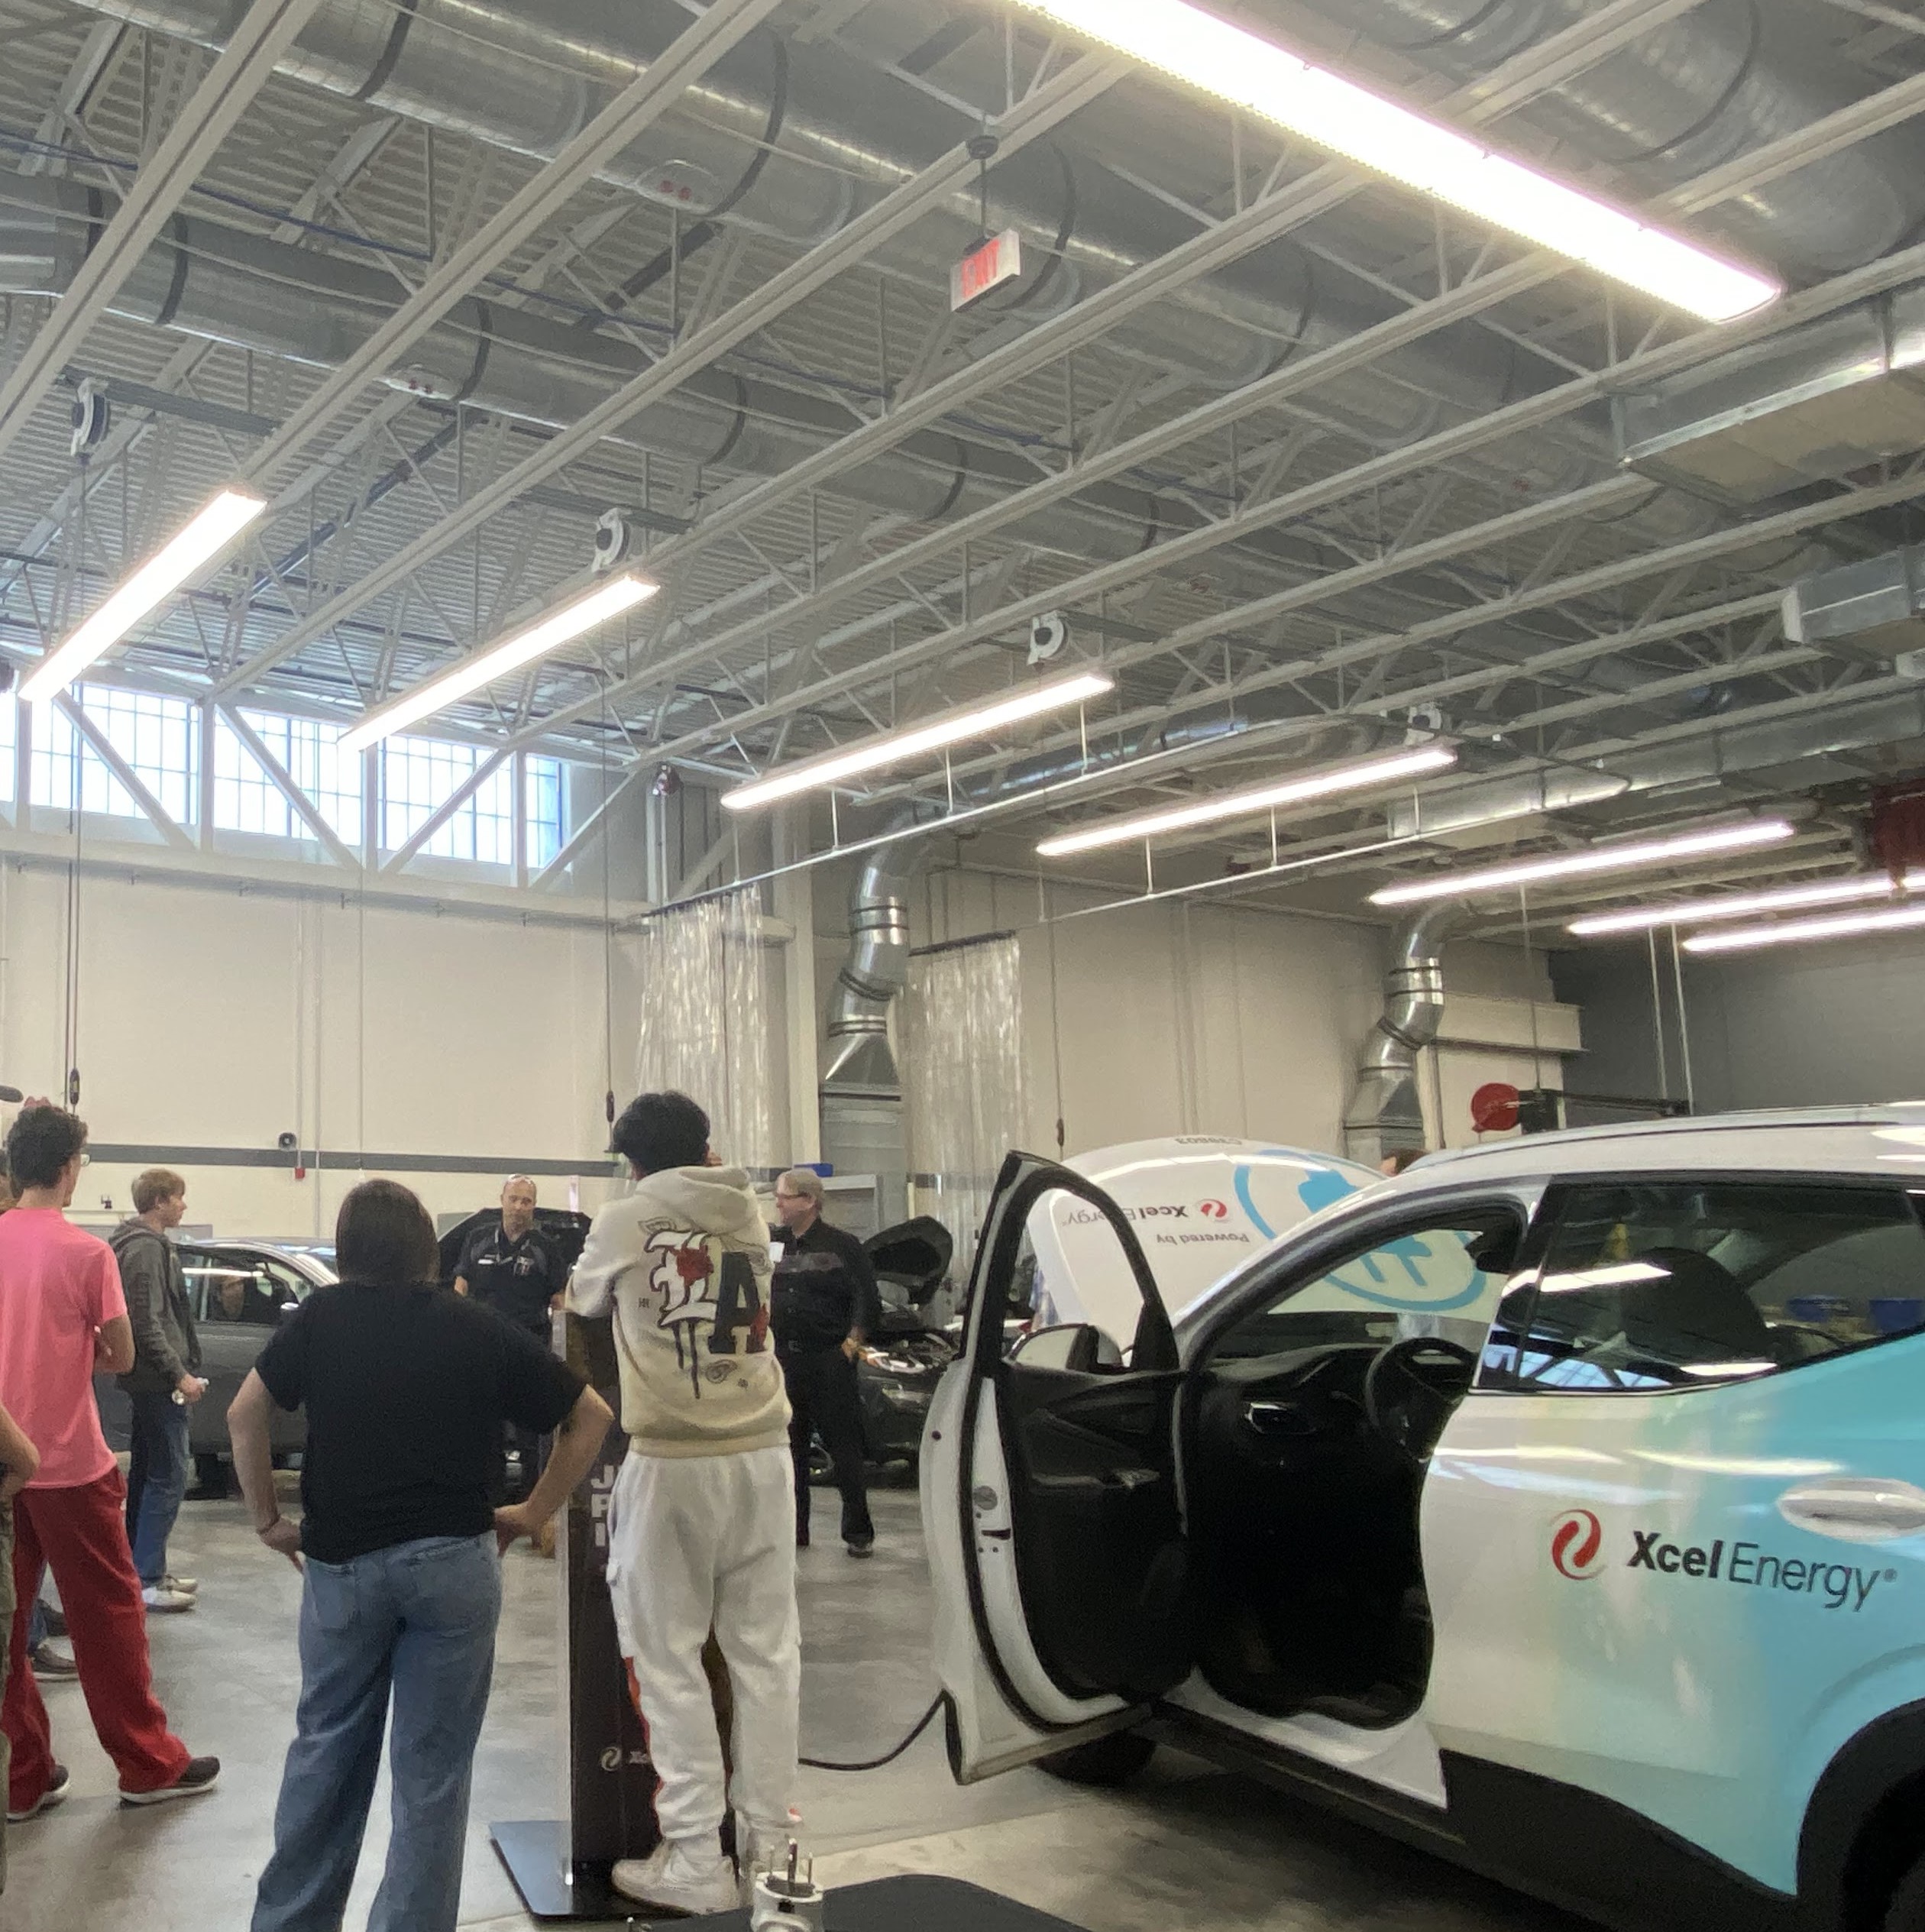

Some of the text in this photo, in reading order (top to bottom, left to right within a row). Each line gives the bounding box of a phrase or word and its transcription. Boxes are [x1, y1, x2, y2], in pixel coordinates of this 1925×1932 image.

[1156, 1232, 1250, 1245] Powered by
[1628, 1530, 1724, 1578] Xcel
